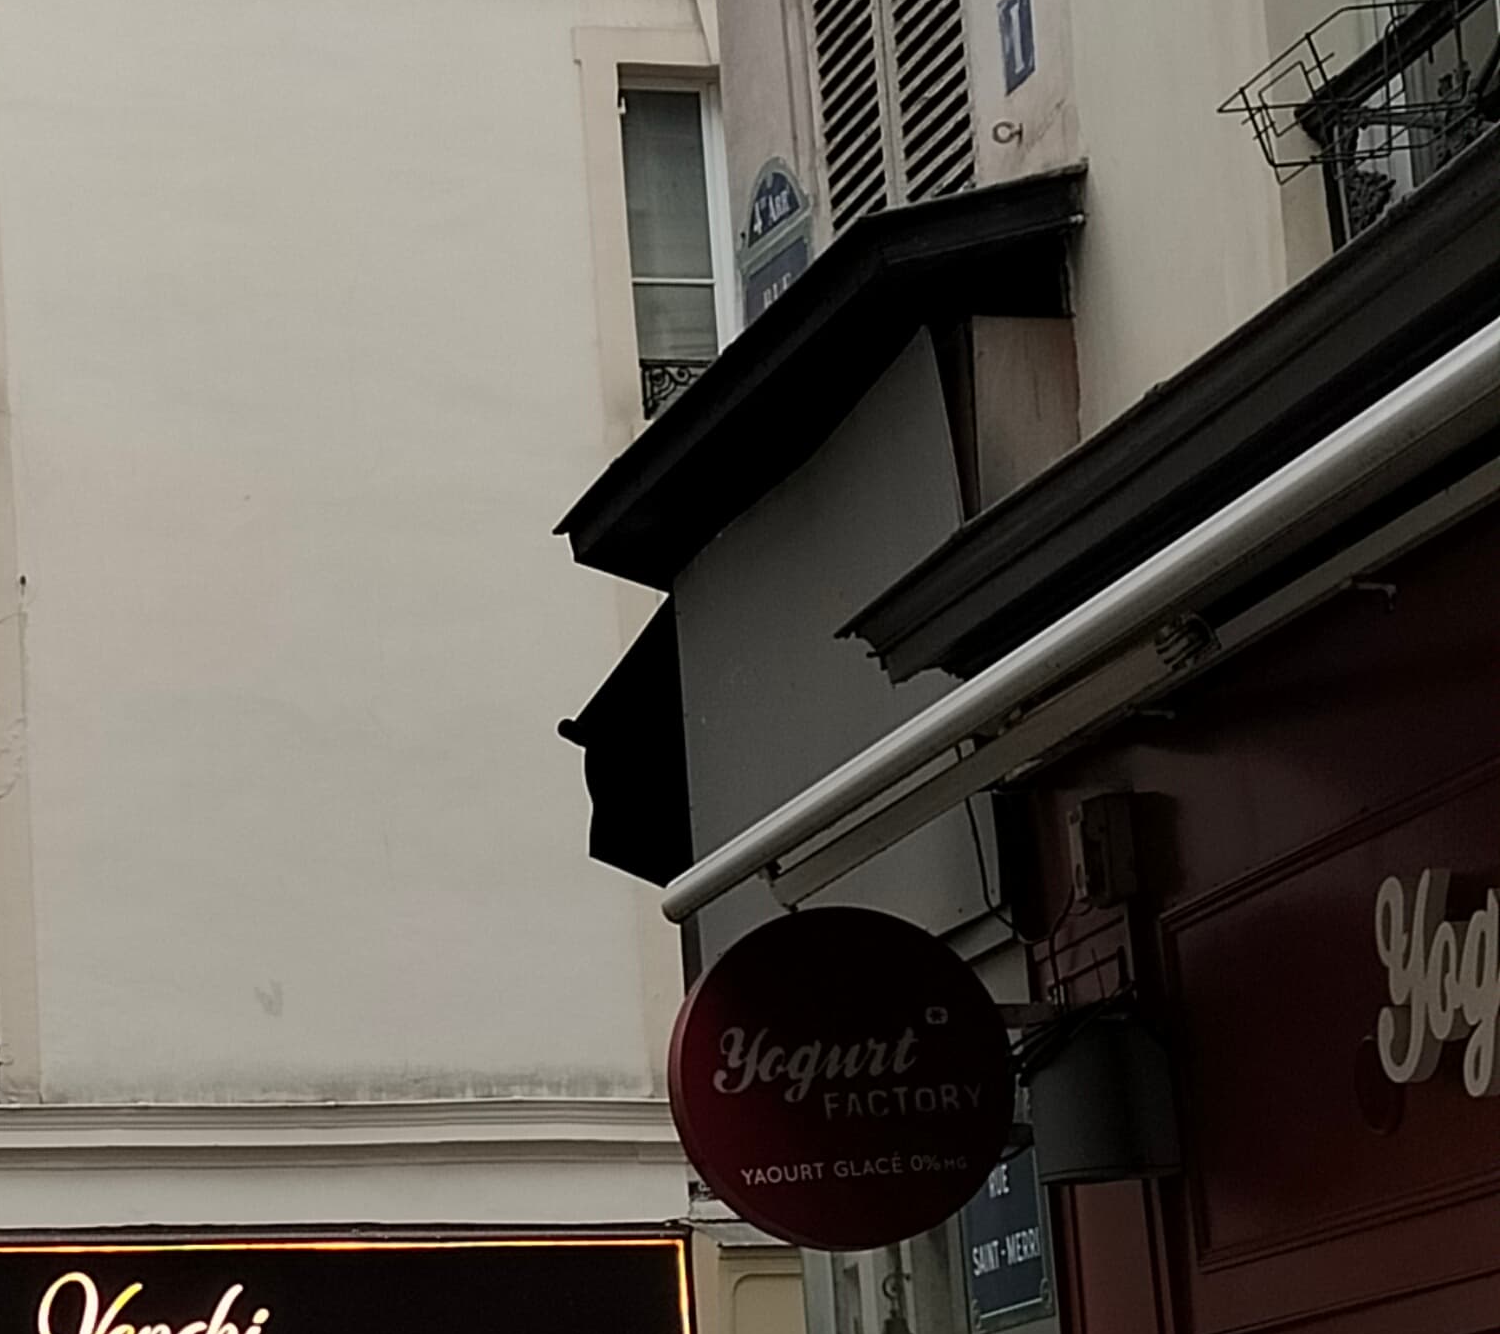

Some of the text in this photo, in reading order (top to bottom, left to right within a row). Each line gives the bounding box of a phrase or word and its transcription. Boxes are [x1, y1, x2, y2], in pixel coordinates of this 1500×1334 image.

[1376, 868, 1500, 1097] Yog
[713, 1026, 919, 1102] Yogurt
[823, 1083, 982, 1120] FACTORY
[741, 1162, 825, 1185] YAOURT
[833, 1151, 903, 1178] GLACÉ
[910, 1155, 941, 1171] 0%
